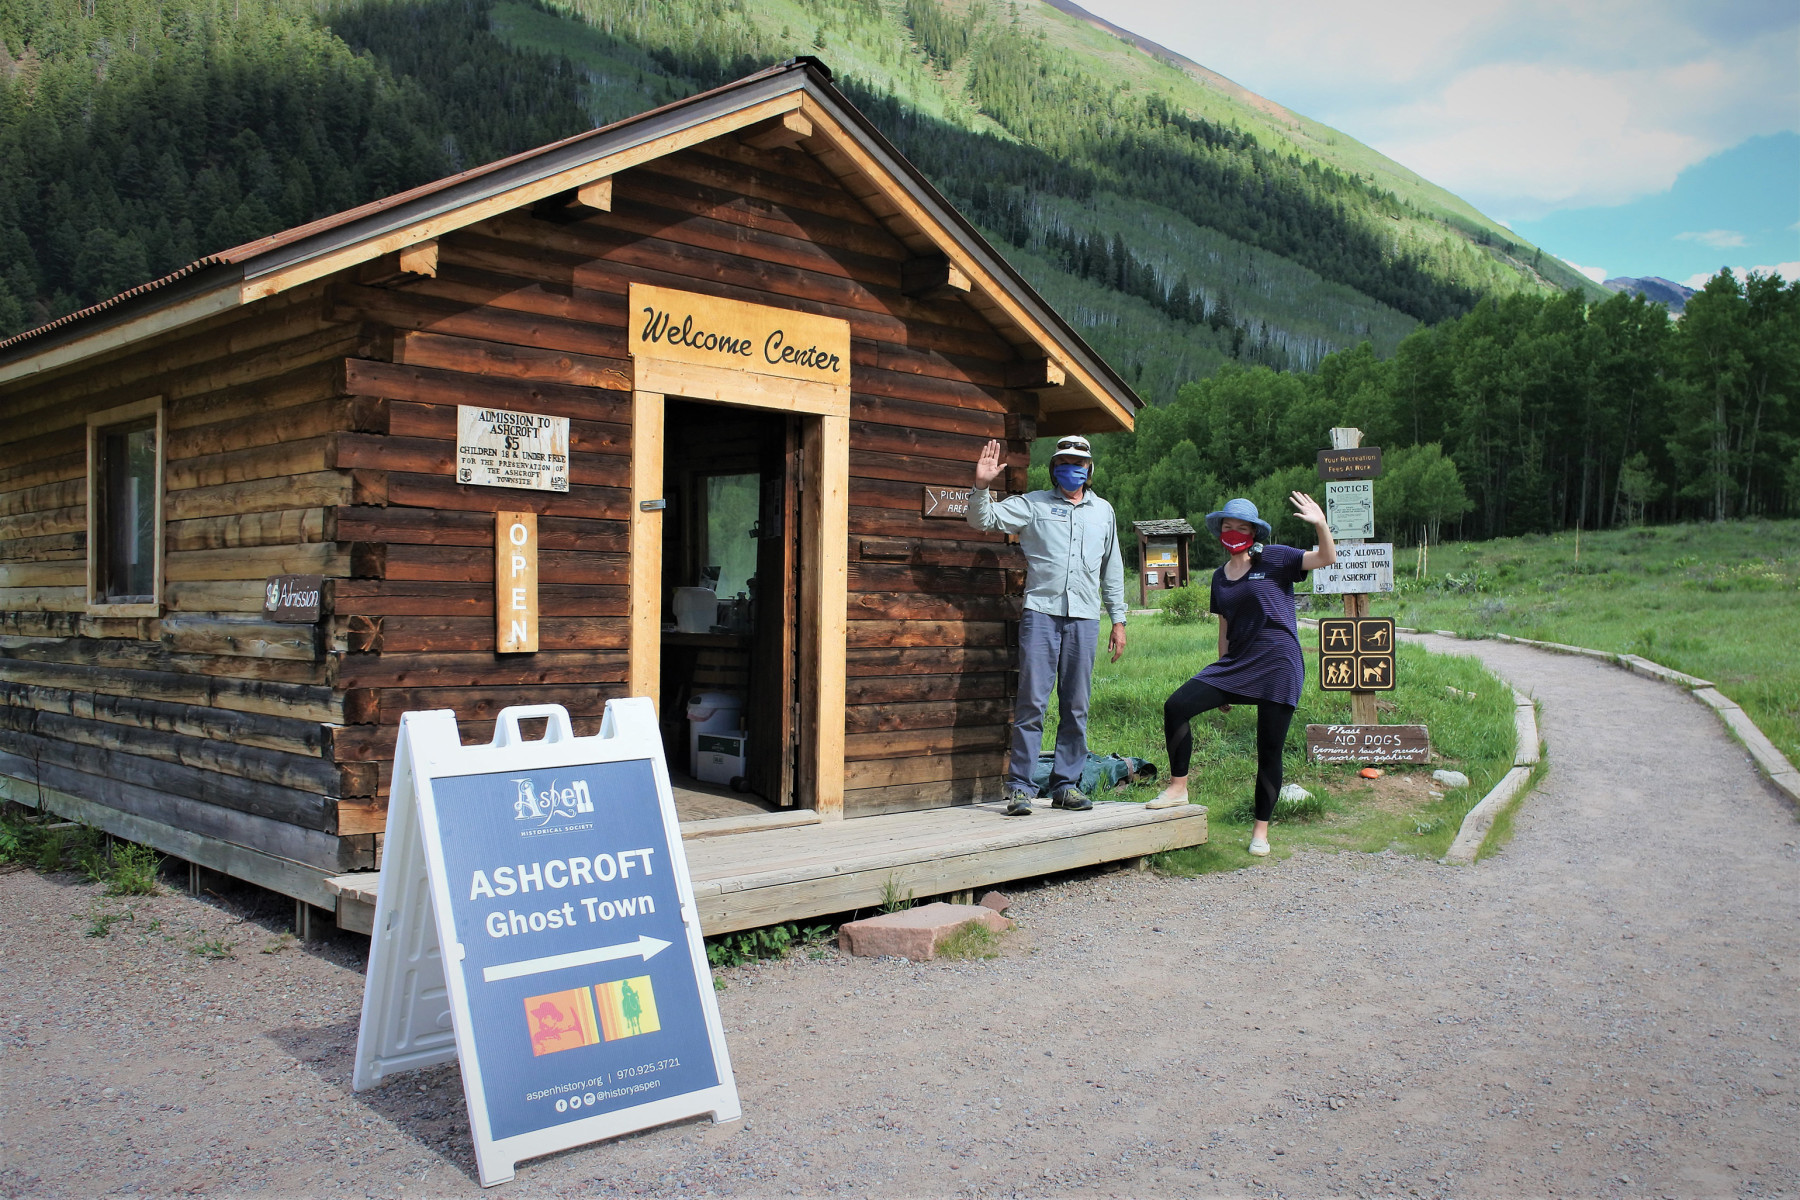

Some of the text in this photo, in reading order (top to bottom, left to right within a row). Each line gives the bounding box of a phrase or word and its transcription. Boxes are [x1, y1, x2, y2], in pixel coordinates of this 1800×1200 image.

[641, 306, 840, 373] Welcome Center
[478, 410, 551, 429] ADMISSION TO
[490, 424, 539, 438] ASHCROFT
[504, 436, 520, 450] $5
[459, 446, 567, 463] CHILDREN 18 & UNDER FREE
[461, 457, 477, 465] FOR
[498, 461, 551, 472] PRESERVATION
[487, 467, 541, 478] THE ASHCROFT
[496, 476, 532, 486] TOWNSITE
[940, 490, 969, 500] PICNIC
[1330, 484, 1369, 493] NOTICE
[1354, 548, 1386, 557] ALLOWED
[1330, 562, 1344, 570] THE
[1345, 561, 1368, 570] GHOST
[1371, 560, 1390, 569] TOWN
[509, 523, 528, 643] OPEN
[1329, 573, 1377, 582] OF ASHCROFT
[278, 580, 319, 607] Admission
[1327, 726, 1360, 735] Please
[1334, 734, 1402, 746] NO DOGS
[1358, 747, 1386, 755] hawks
[1373, 753, 1413, 763] gophers
[510, 778, 594, 826] Aspen
[521, 823, 594, 837] HISTORICAL SOCIETY
[469, 848, 655, 901] ASHCROFT
[486, 894, 656, 938] Ghost Town
[526, 1076, 603, 1100] aspenhistory.org
[617, 1057, 680, 1080] 970.925.3721
[596, 1079, 661, 1101] @historyaspen
